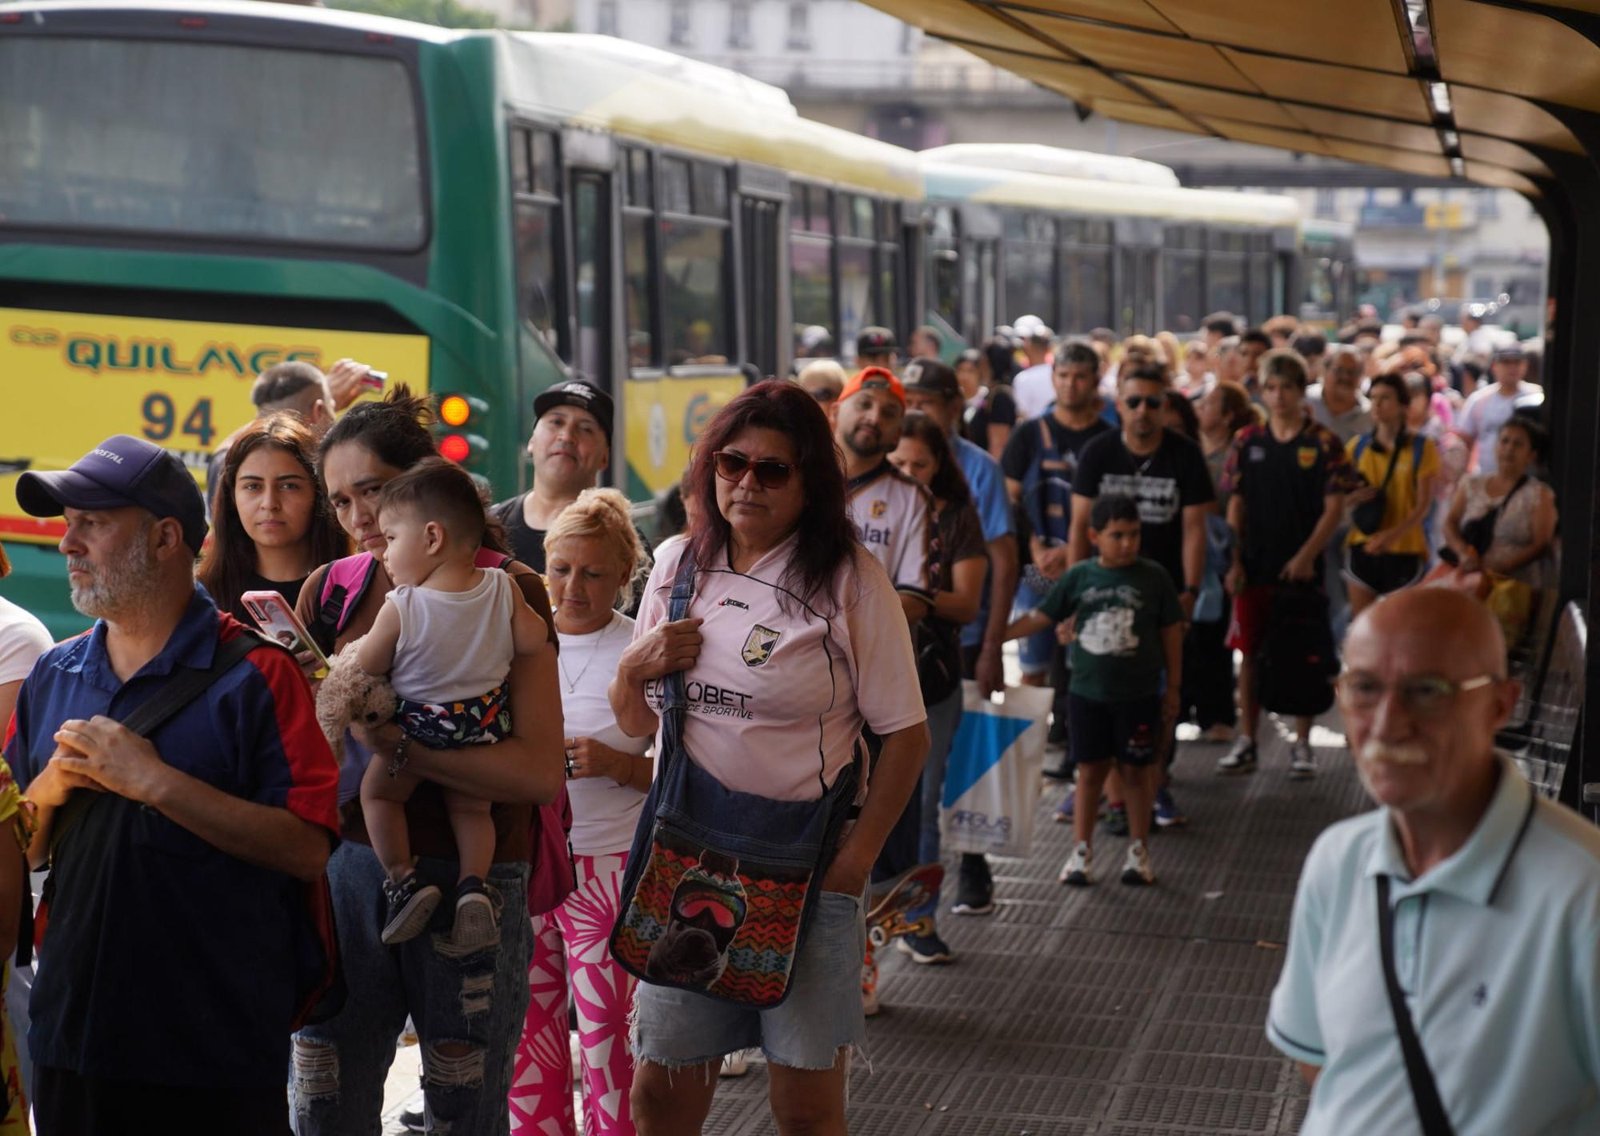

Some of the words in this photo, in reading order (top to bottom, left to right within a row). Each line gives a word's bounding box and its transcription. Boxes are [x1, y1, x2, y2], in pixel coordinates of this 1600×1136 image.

[142, 393, 215, 446] 94
[646, 679, 753, 709] EUOBET
[702, 706, 754, 720] SPORTIVE
